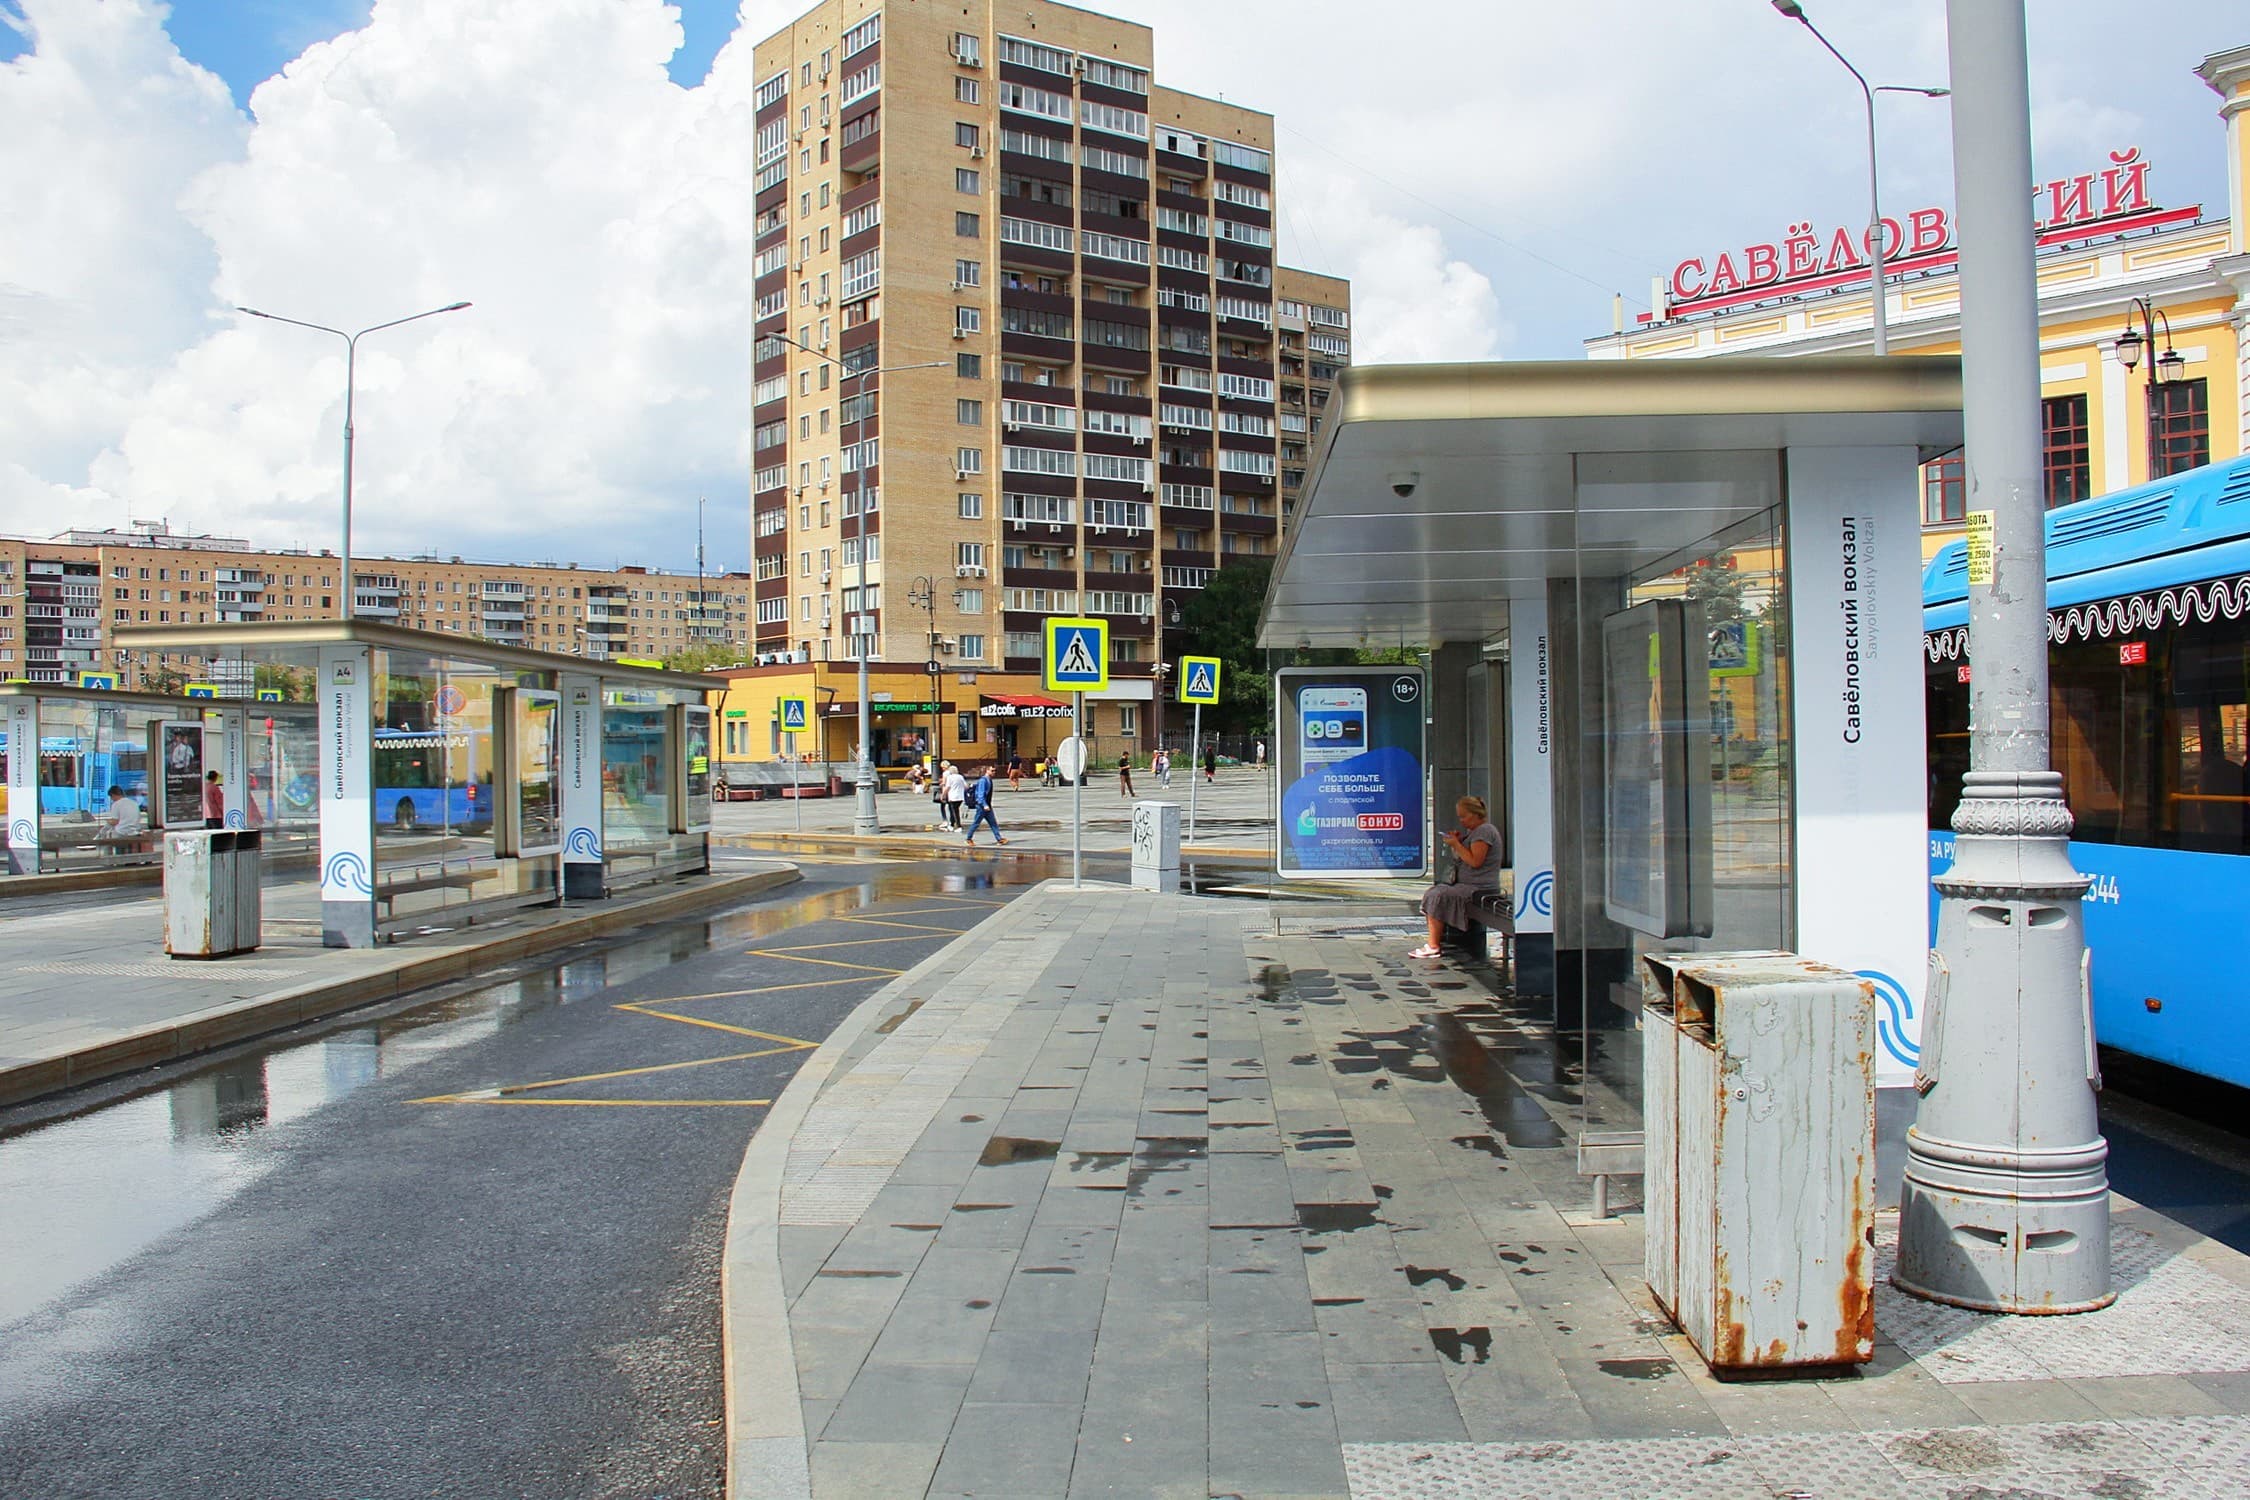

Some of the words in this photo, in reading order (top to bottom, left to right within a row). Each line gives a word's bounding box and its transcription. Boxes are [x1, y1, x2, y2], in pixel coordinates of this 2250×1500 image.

[1672, 145, 2152, 301] САВЁЛОВИЙ
[1840, 517, 1857, 593] вокзал
[1861, 516, 1875, 563] Vokzal
[1862, 566, 1879, 660] Savyolovskiy
[1537, 635, 1547, 676] вокзал
[1840, 598, 1861, 744] Савёловский
[1396, 683, 1416, 694] 18+
[335, 692, 343, 729] вокзал
[1020, 706, 1045, 718] TELE2
[1046, 705, 1074, 718] cofix
[1537, 678, 1549, 754] Савёловский
[334, 731, 345, 800] Савёловский
[574, 738, 582, 789] Савёловский
[1323, 774, 1380, 783] ПОЗВОЛЬТЕ
[1318, 784, 1343, 793] СЕБЕ
[1344, 784, 1385, 793] БОЛЬШЕ
[1334, 796, 1375, 805] подпиской
[1316, 816, 1356, 828] ГАЗПРОМ
[1359, 816, 1400, 828] БОНУС
[1321, 838, 1384, 846] gazprombonus.ru
[1930, 840, 1943, 858] ЗА
[1943, 841, 1957, 861] РУ
[2079, 872, 2120, 905] 544
